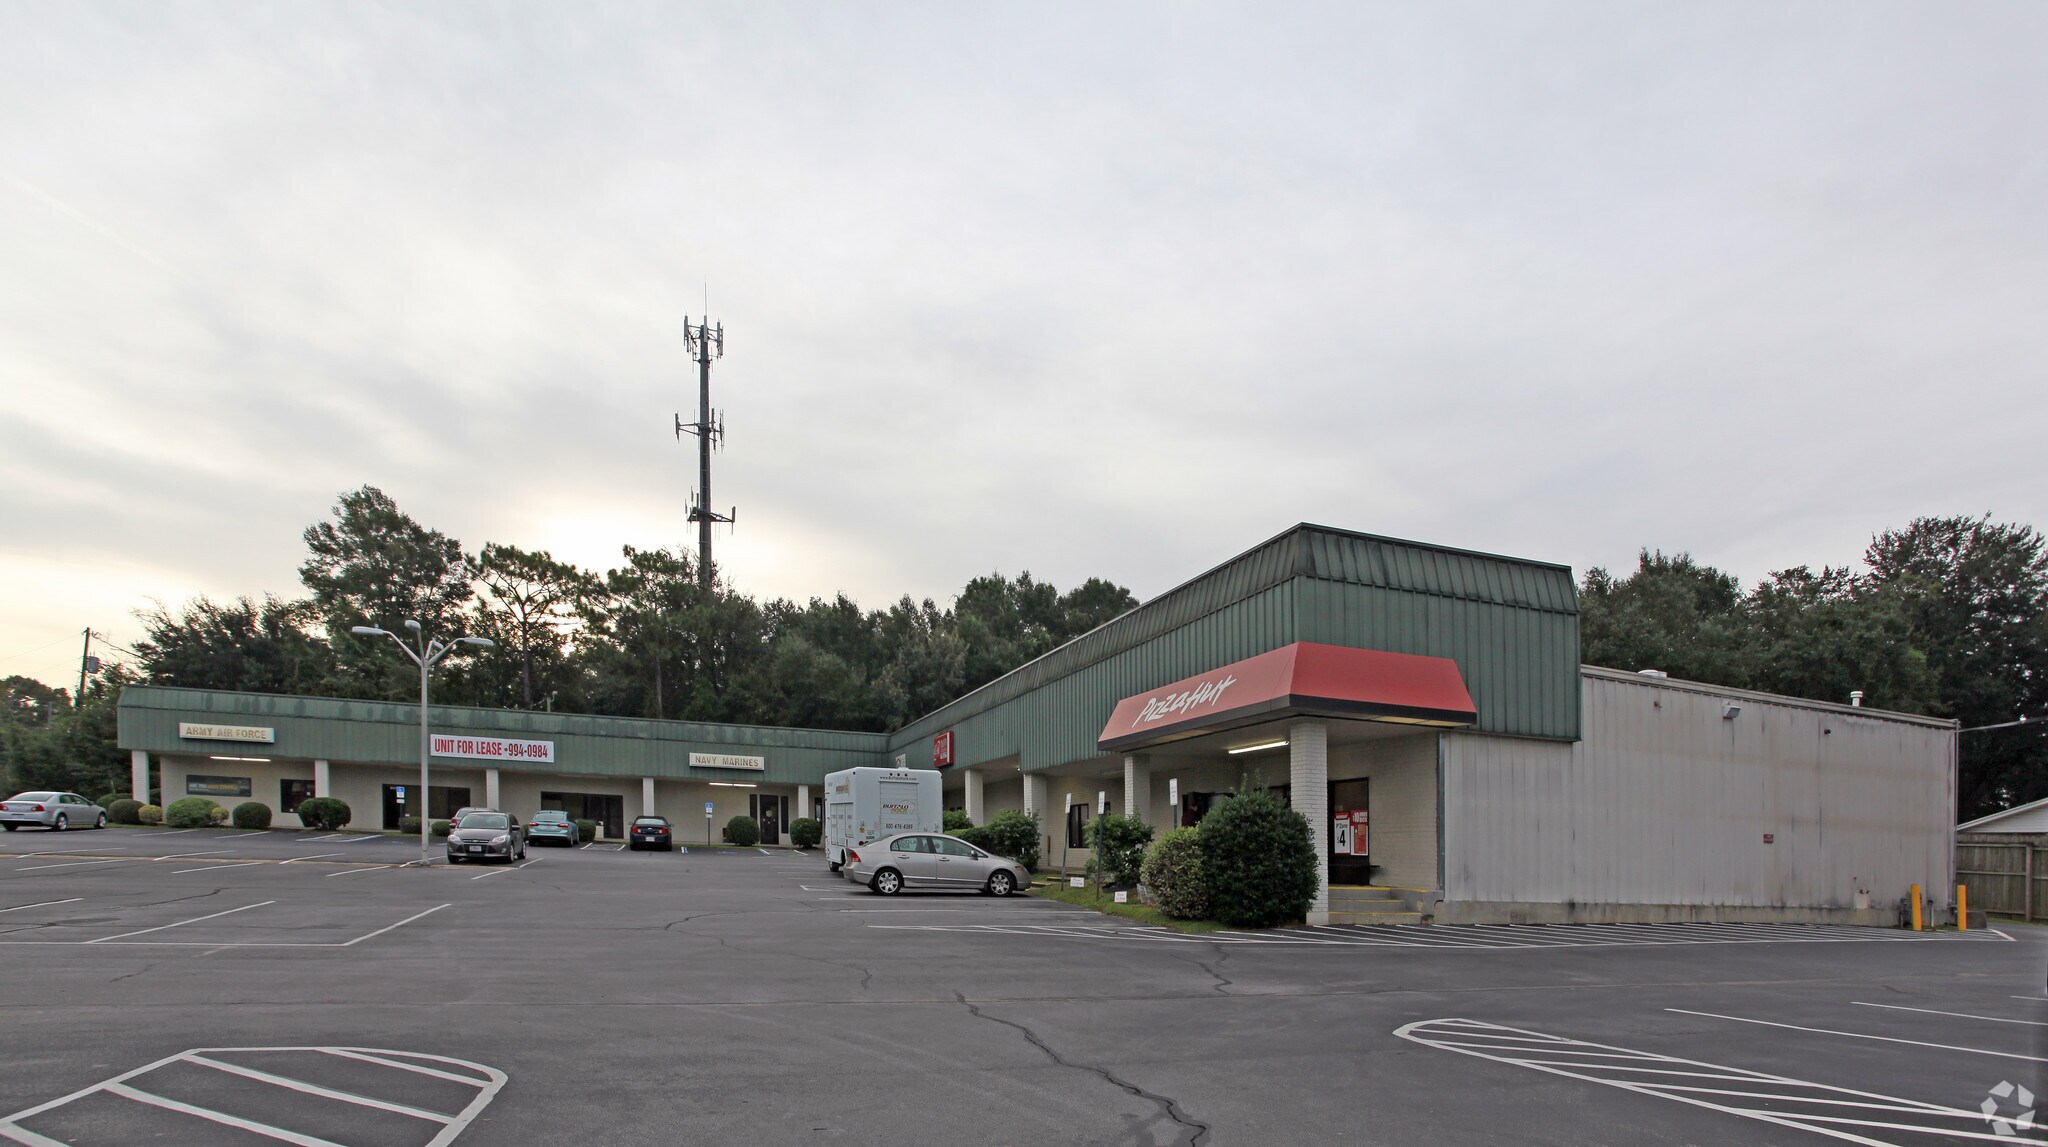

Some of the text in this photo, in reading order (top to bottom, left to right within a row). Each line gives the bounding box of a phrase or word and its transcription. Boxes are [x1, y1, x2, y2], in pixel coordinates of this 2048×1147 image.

[186, 727, 267, 739] ARMY AIR FORCE
[434, 739, 455, 753] UNIT
[457, 740, 474, 754] FOR
[476, 741, 502, 755] LEASE
[695, 756, 759, 767] NAVY MARINES
